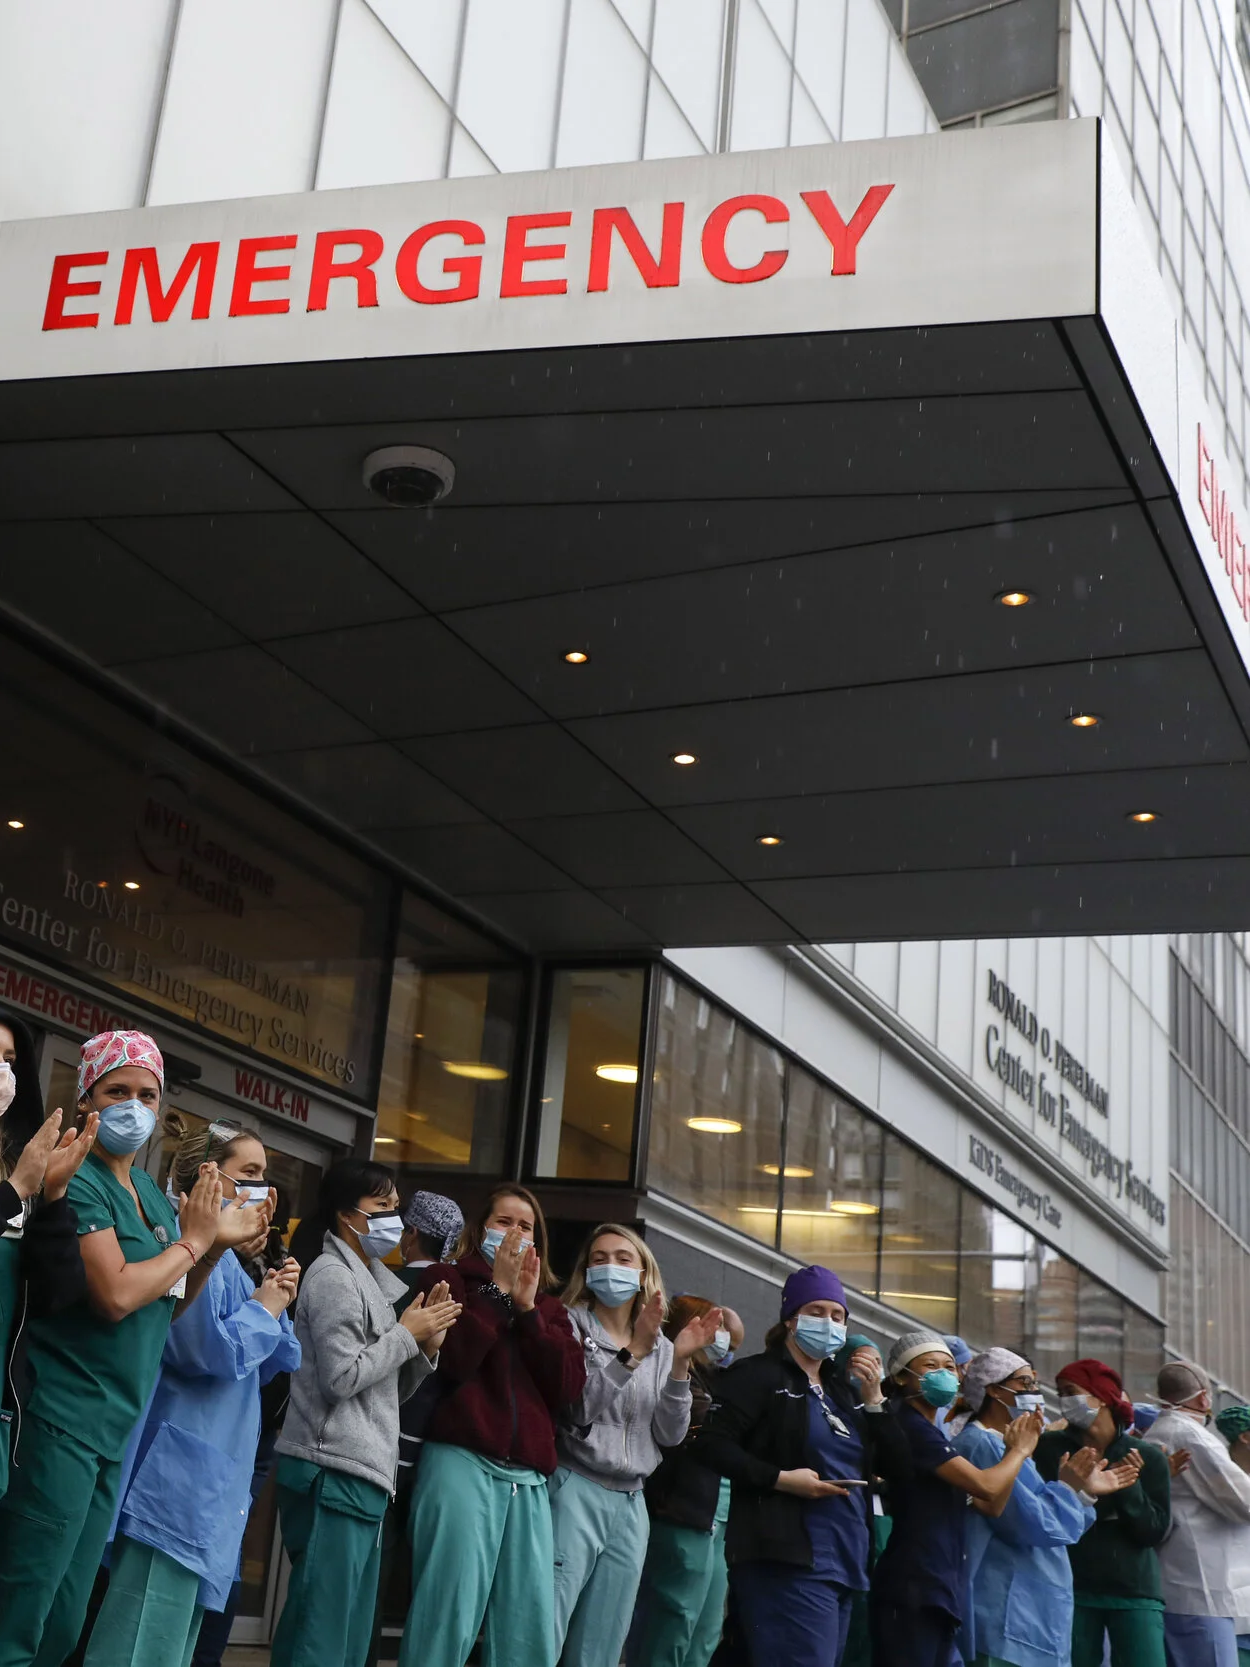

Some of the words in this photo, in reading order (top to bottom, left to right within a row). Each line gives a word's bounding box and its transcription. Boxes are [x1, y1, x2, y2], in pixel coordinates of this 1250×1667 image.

[42, 183, 896, 332] EMERGENCY
[176, 856, 244, 920] Health
[192, 823, 275, 898] Langone
[63, 868, 165, 941] RONALD
[201, 940, 310, 1018] PERELMAN
[85, 926, 125, 974] for
[130, 947, 264, 1048] Emergency
[269, 1016, 357, 1085] Services
[988, 968, 1038, 1046] RONALD
[235, 1067, 310, 1123] WALK-IN
[986, 1024, 1034, 1108] Center
[1038, 1072, 1058, 1128] for
[1059, 1093, 1125, 1199] Emergency
[1125, 1159, 1165, 1227] Services
[994, 1154, 1043, 1221] Emergency
